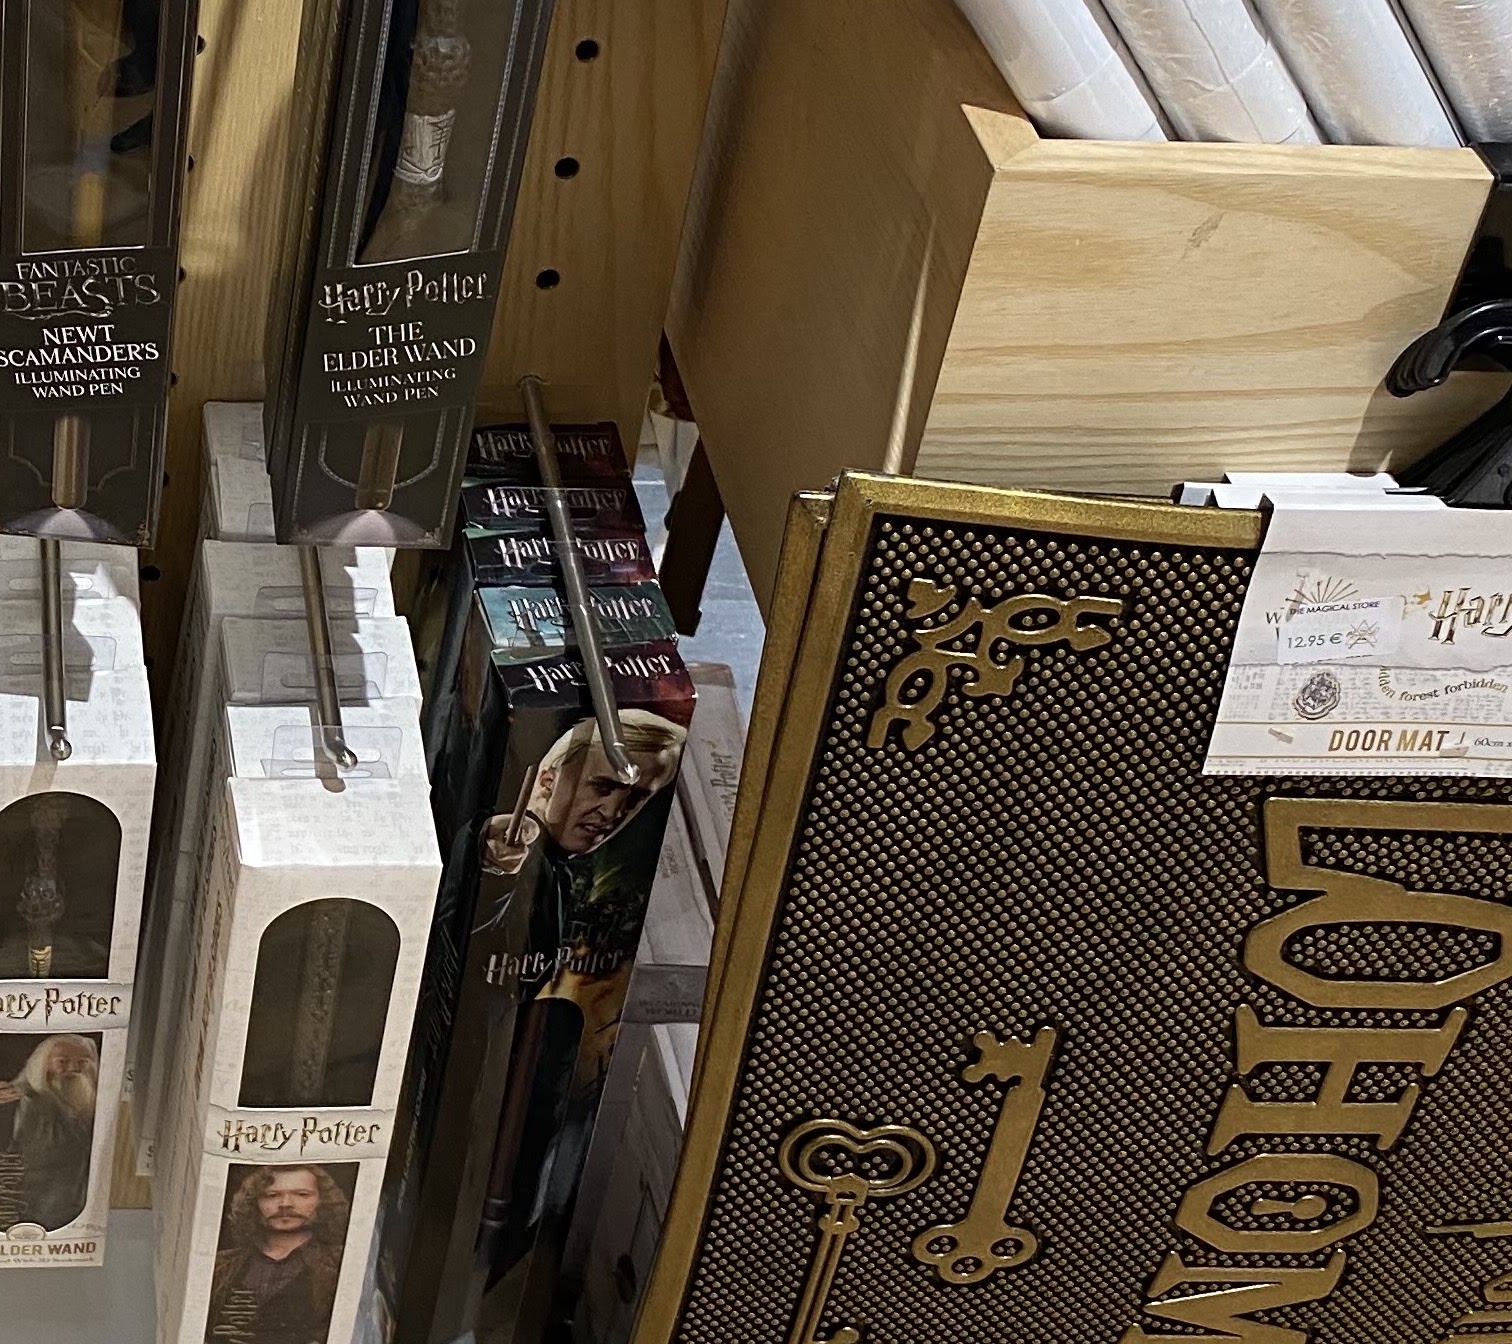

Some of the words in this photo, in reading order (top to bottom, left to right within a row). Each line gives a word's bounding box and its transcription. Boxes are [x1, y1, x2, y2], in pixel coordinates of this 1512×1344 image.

[15, 255, 138, 281] FANTASTIC
[318, 281, 401, 324] Harry
[404, 268, 489, 309] Potter
[42, 324, 116, 346] NEWT
[368, 320, 425, 346] THE
[322, 346, 400, 374] ELDER
[403, 337, 478, 364] WAND
[14, 366, 142, 385] ILLUMINATING
[330, 366, 457, 394] ILLUMINATING
[31, 384, 86, 399] WAND
[89, 382, 125, 397] PEN
[343, 391, 399, 409] WAND
[404, 386, 439, 402] PEN
[1288, 605, 1307, 616] THE
[1306, 602, 1351, 615] MAGICAL
[1352, 599, 1381, 611] STORE
[1287, 634, 1327, 650] 12.95
[1328, 631, 1343, 645] €
[1398, 688, 1441, 703] forest
[1443, 677, 1510, 696] forbidden
[1327, 728, 1393, 753] DOOR
[1395, 728, 1450, 753] MAT
[1473, 736, 1505, 749] 60cm
[483, 951, 553, 987] Harry
[43, 987, 123, 1027] Potter
[216, 1119, 298, 1154] Harry
[299, 1116, 382, 1157] Potter
[46, 1241, 97, 1256] WAND
